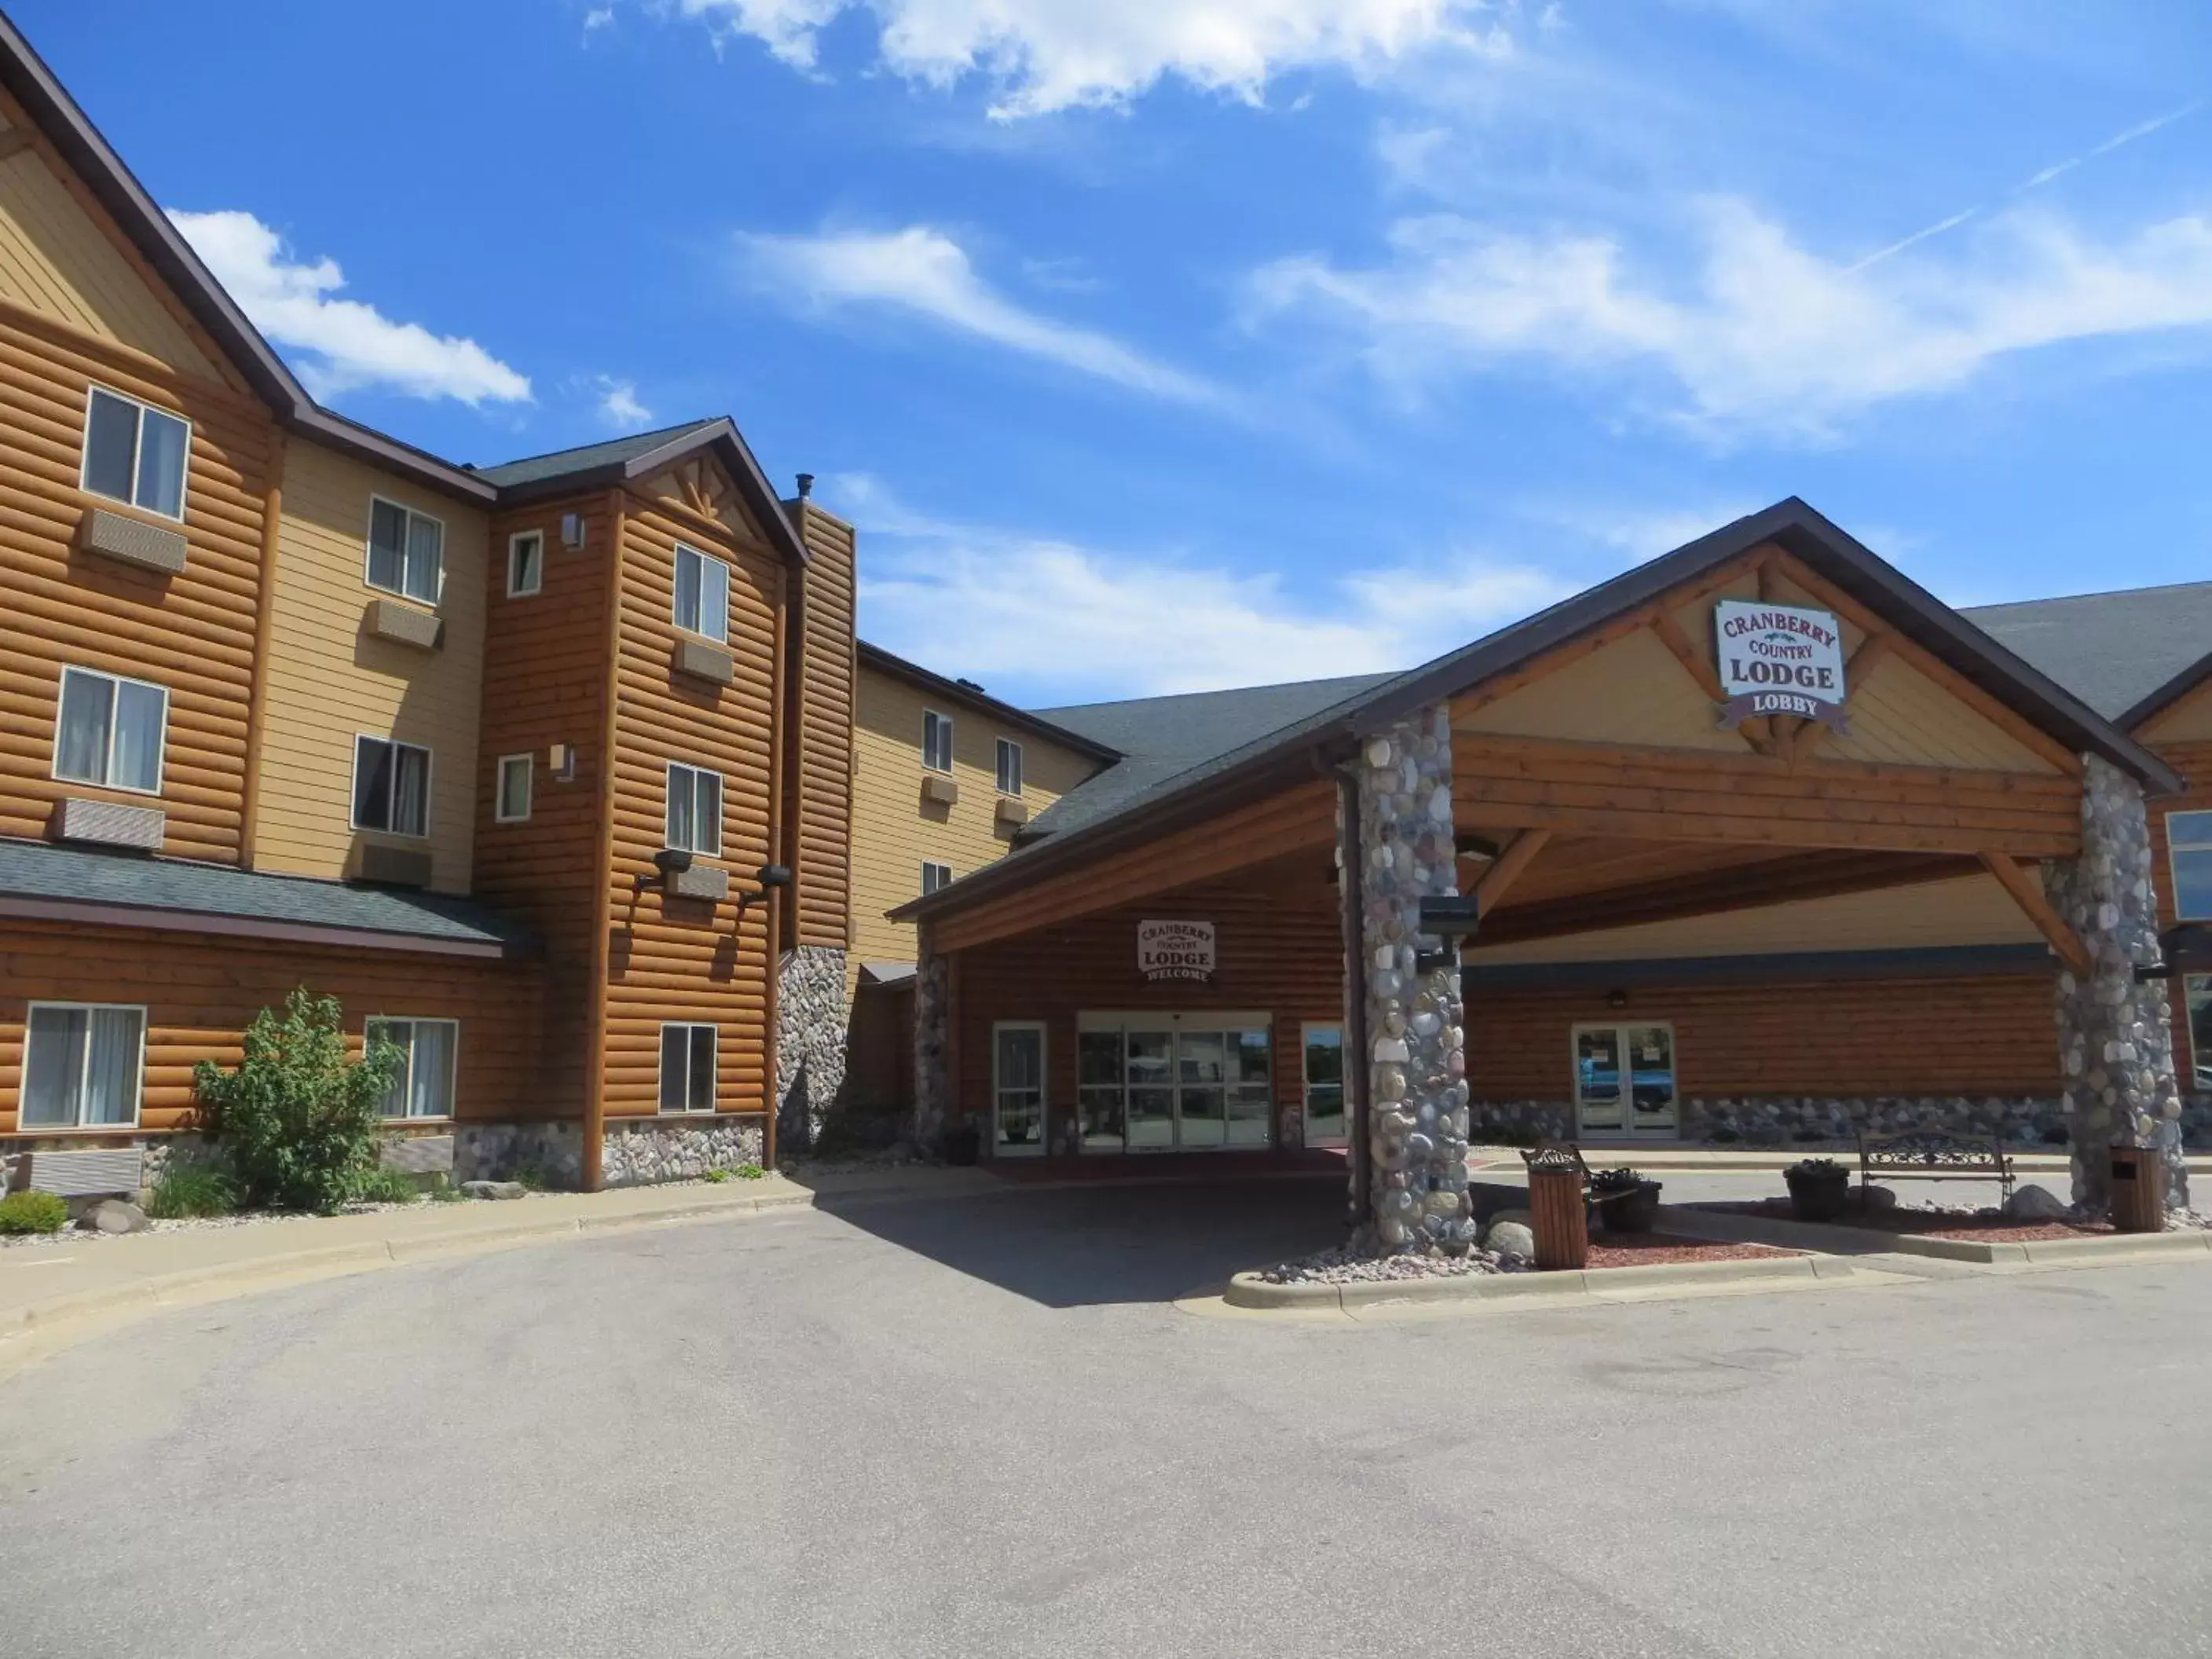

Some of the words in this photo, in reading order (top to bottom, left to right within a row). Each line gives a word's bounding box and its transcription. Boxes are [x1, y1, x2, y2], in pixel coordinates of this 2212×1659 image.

[1723, 613, 1837, 649] CRANBERRY
[1749, 639, 1813, 660] COUNTRY
[1730, 658, 1834, 689] LODGE
[1752, 694, 1818, 716] LOBBY
[1144, 951, 1210, 965] LODGE
